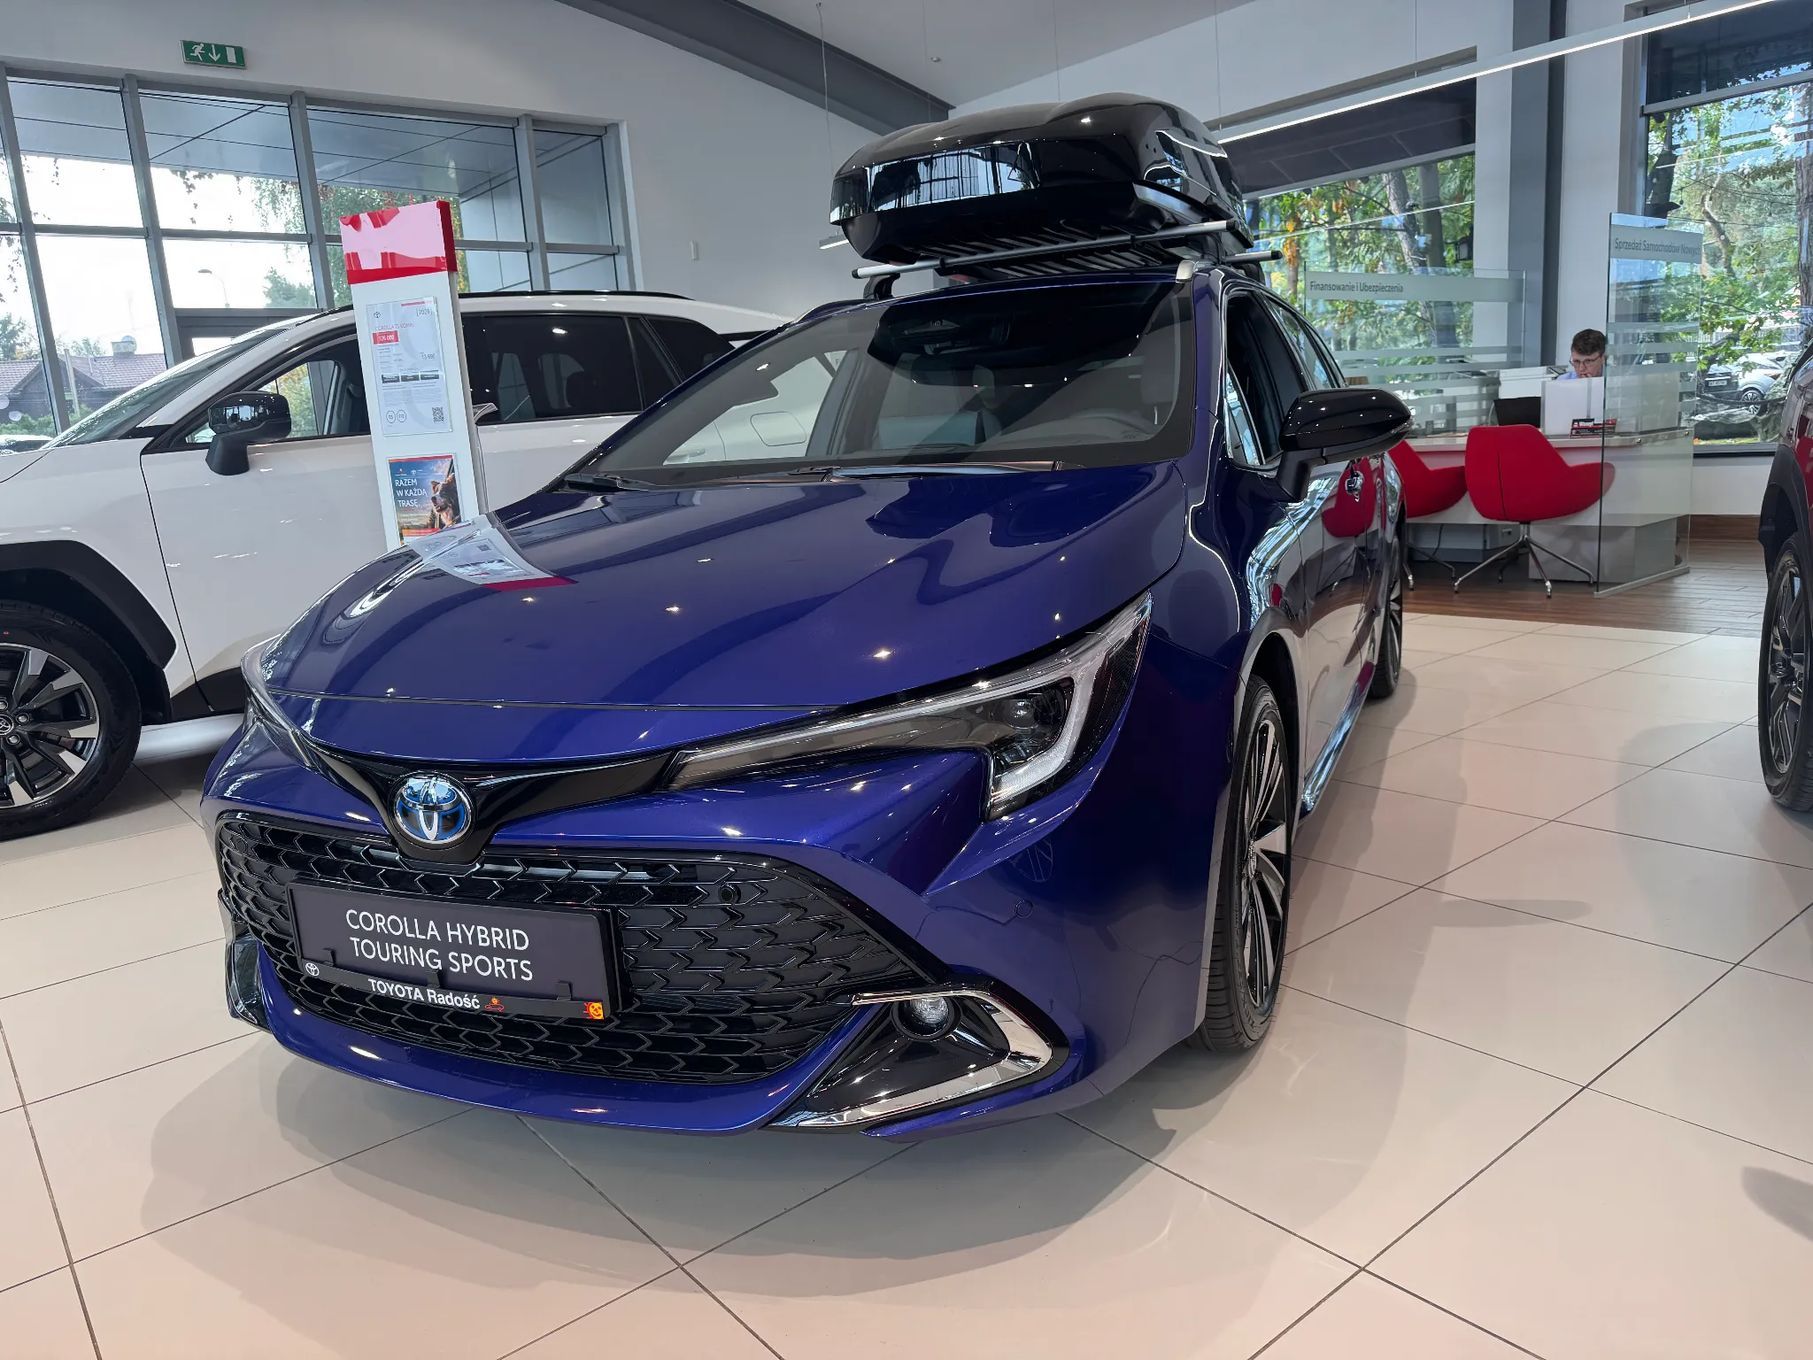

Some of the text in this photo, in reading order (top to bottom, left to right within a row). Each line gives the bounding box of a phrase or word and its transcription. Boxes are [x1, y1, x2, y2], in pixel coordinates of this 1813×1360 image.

[1309, 280, 1355, 292] Finansowanie
[1359, 282, 1404, 294] Ubezpieczenia
[395, 478, 418, 487] RAZEM
[396, 489, 404, 497] W
[345, 909, 530, 951] COROLLA HYBRID
[349, 936, 533, 981] TOURING SPORTS
[367, 978, 481, 1010] TOYOTA Radość
